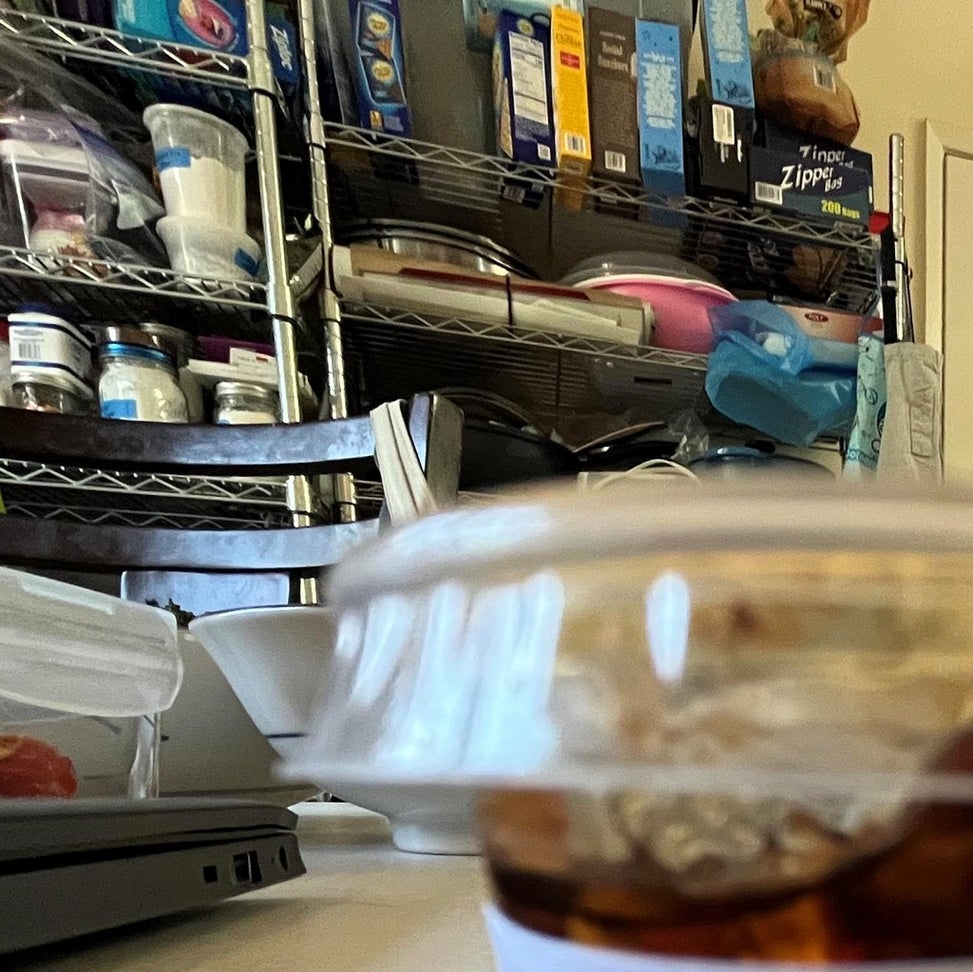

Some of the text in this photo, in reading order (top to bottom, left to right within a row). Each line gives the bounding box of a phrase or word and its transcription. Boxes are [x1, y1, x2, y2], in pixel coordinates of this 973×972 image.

[781, 163, 834, 190] Zipper
[824, 176, 843, 193] Bag
[821, 199, 841, 216] 200
